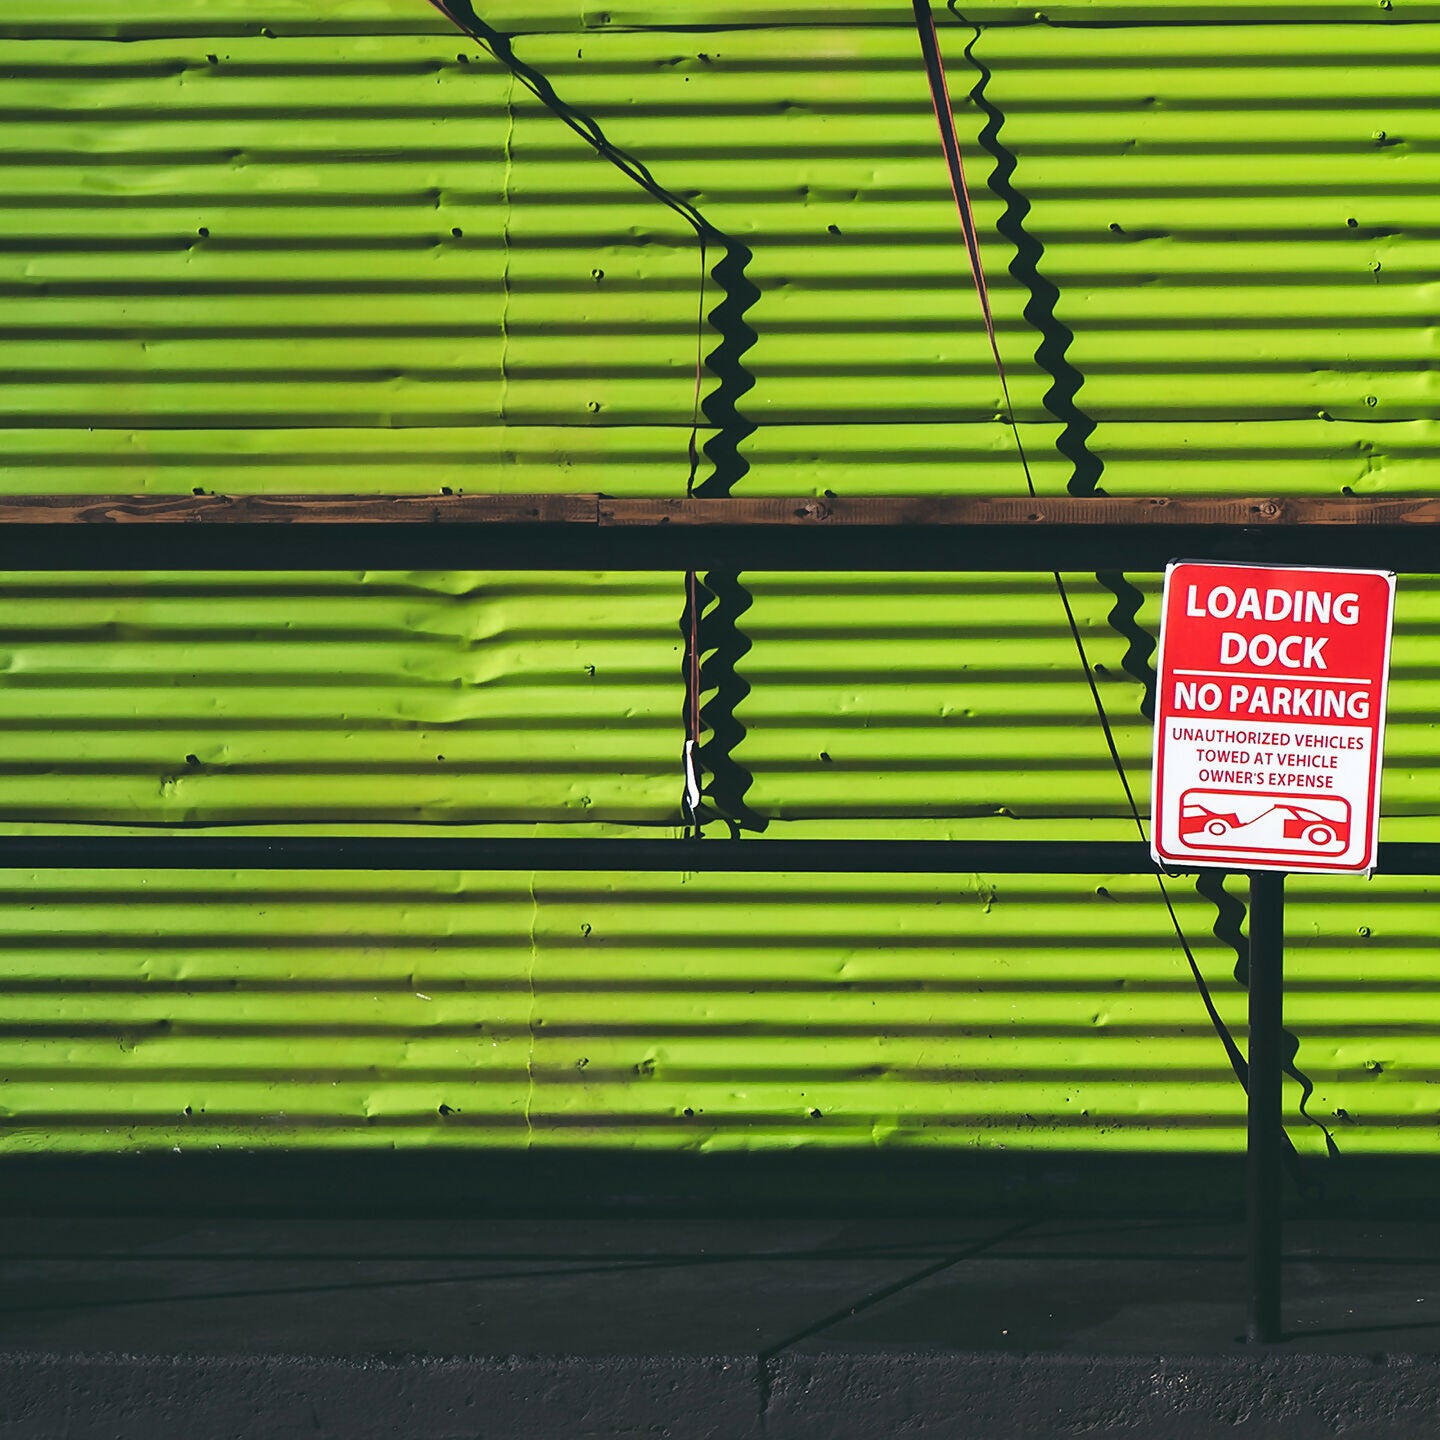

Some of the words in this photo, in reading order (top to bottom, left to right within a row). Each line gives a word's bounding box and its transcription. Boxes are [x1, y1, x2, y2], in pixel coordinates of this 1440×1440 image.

[1186, 584, 1360, 625] LOADING
[1219, 632, 1330, 670] DOCK
[1173, 681, 1223, 711] NO
[1229, 685, 1370, 720] PARKING
[1172, 727, 1290, 747] UNAUTHORIZED
[1295, 734, 1364, 750] VEHICLES
[1196, 749, 1251, 765] TOWED
[1253, 753, 1274, 766] AT
[1277, 753, 1338, 769] VEHICLE
[1199, 769, 1265, 785] OWNER'S
[1268, 774, 1334, 789] EXPENSE
